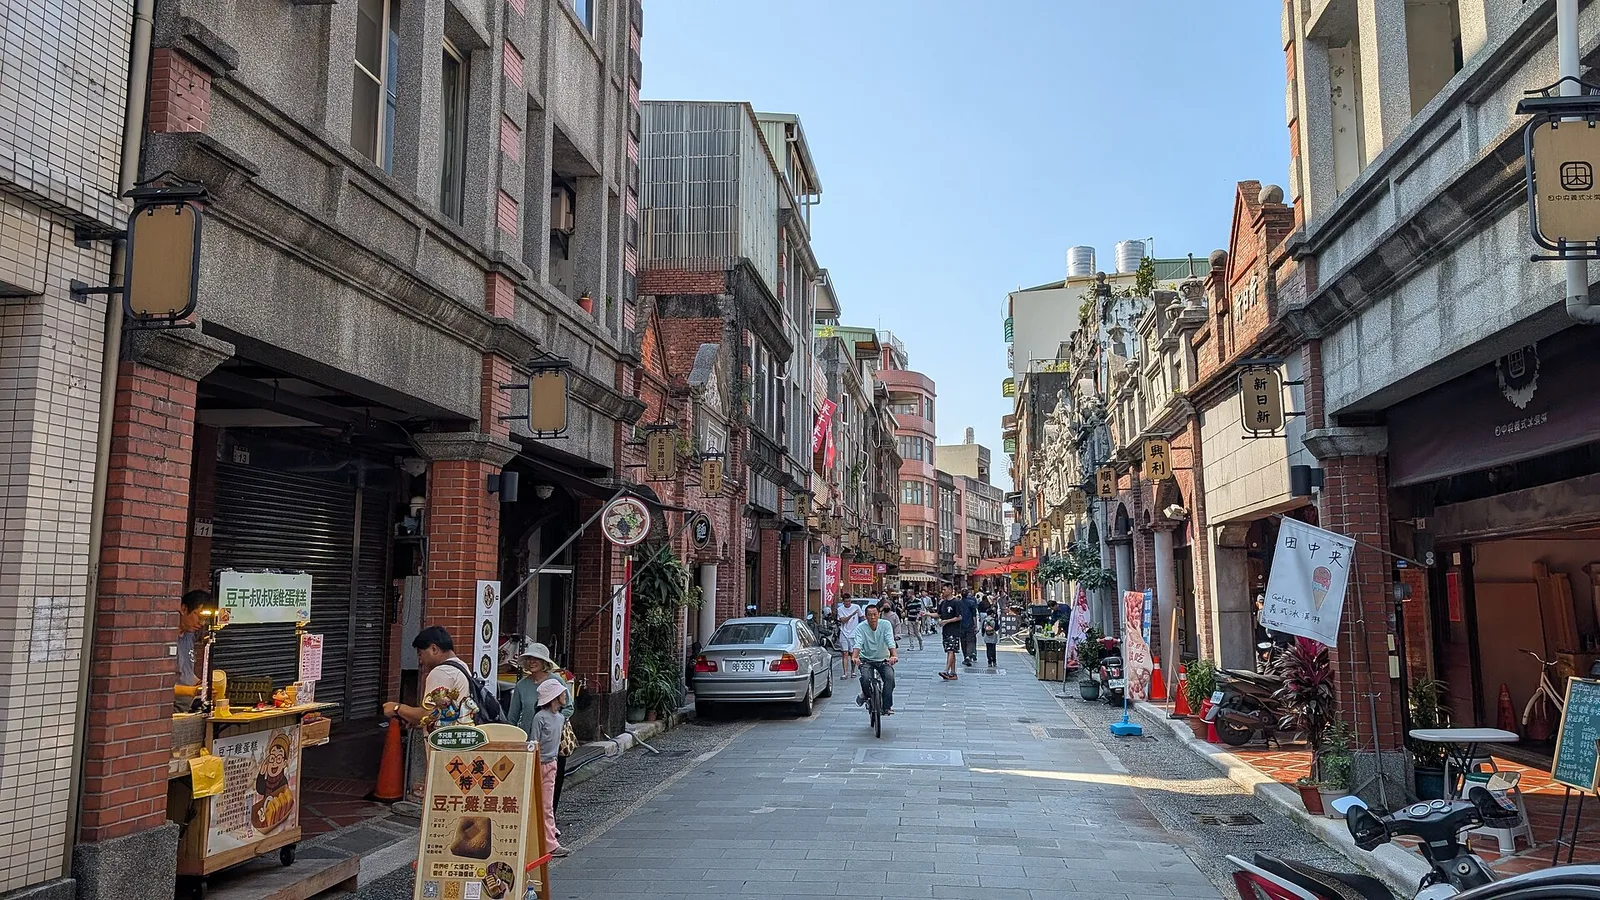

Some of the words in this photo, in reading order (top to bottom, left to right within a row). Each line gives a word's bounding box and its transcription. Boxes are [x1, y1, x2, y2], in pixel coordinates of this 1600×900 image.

[1253, 377, 1270, 424] 新日新
[1150, 444, 1165, 475] 興利
[225, 588, 307, 608] 豆干叔叔雞蛋糕
[1271, 592, 1296, 605] Gelato
[218, 739, 259, 757] 豆干雞蛋糕
[449, 759, 486, 775] 大溪
[459, 775, 496, 791] 特產
[432, 795, 518, 813] 豆干雞蛋糕
